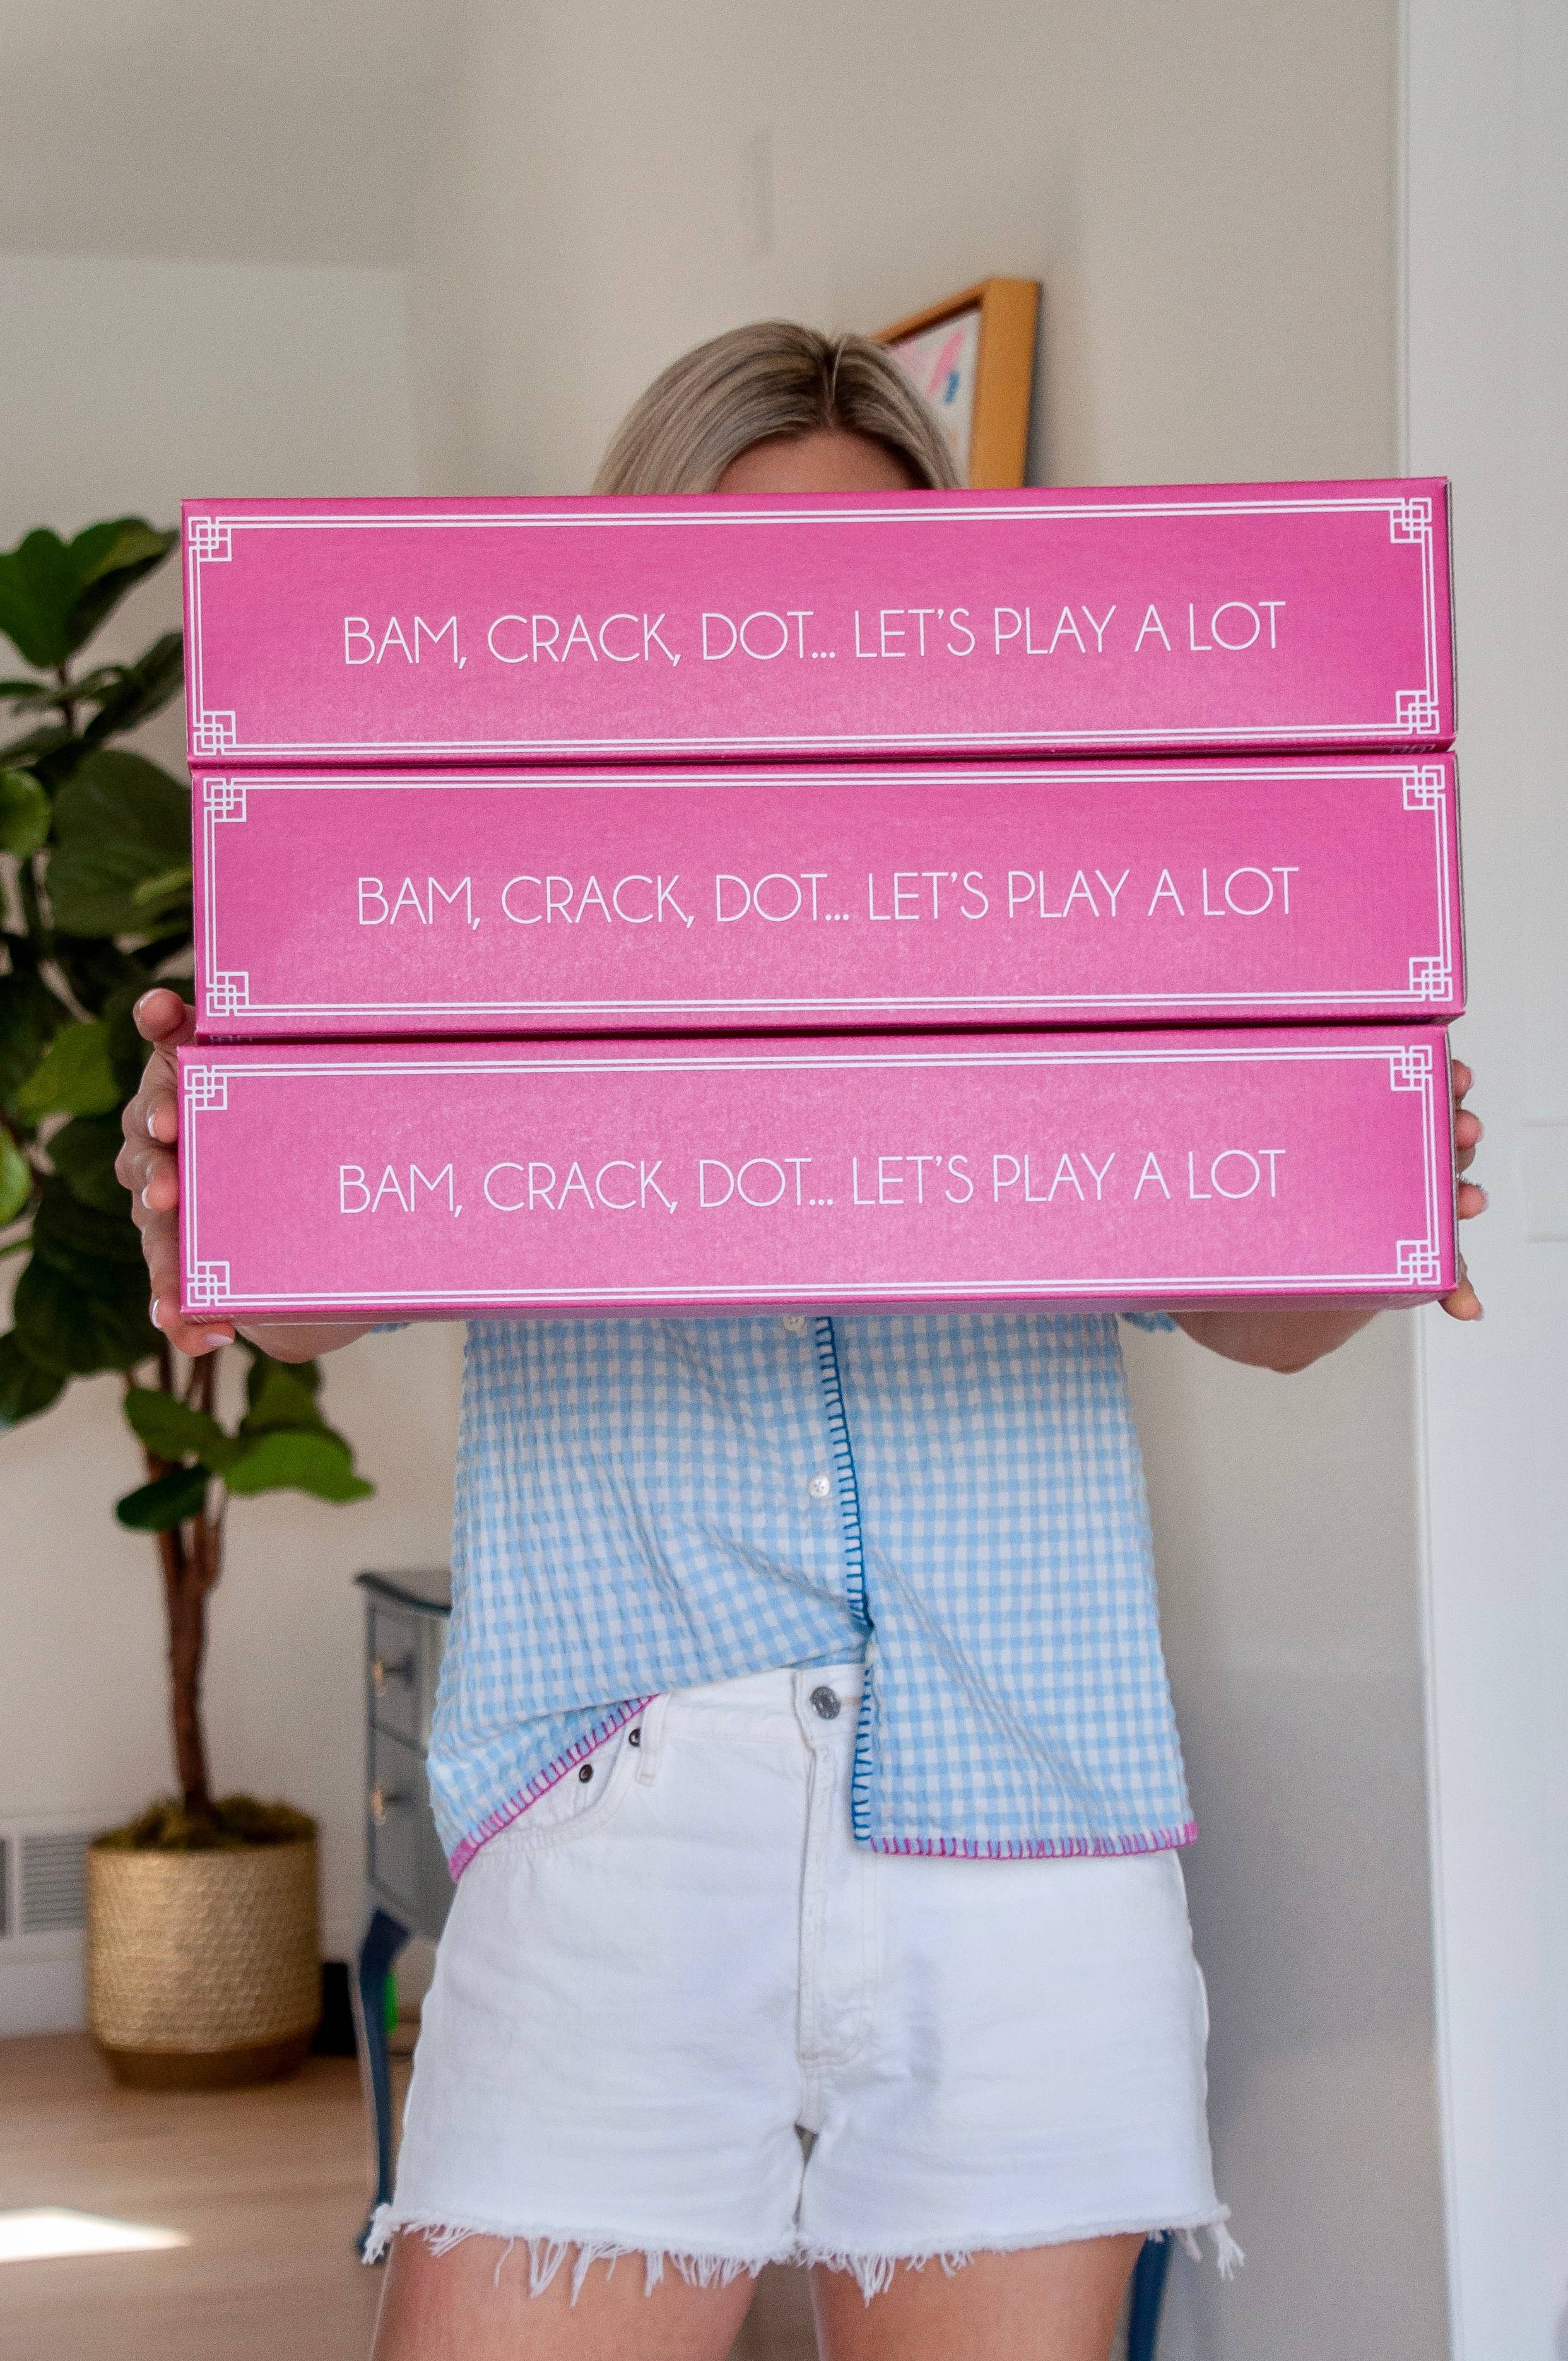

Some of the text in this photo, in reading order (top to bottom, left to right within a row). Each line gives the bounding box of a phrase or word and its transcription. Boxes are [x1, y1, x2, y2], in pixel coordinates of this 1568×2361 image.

[344, 600, 1287, 669] BAM, CRACK, DOT... LET'S PLAY A LOT
[358, 866, 1300, 930] BAM, CRACK, DOT... LET'S PLAY A LOT
[339, 1149, 1286, 1218] BAM, CRACK, DOT... LET'S PLAY A LOT
